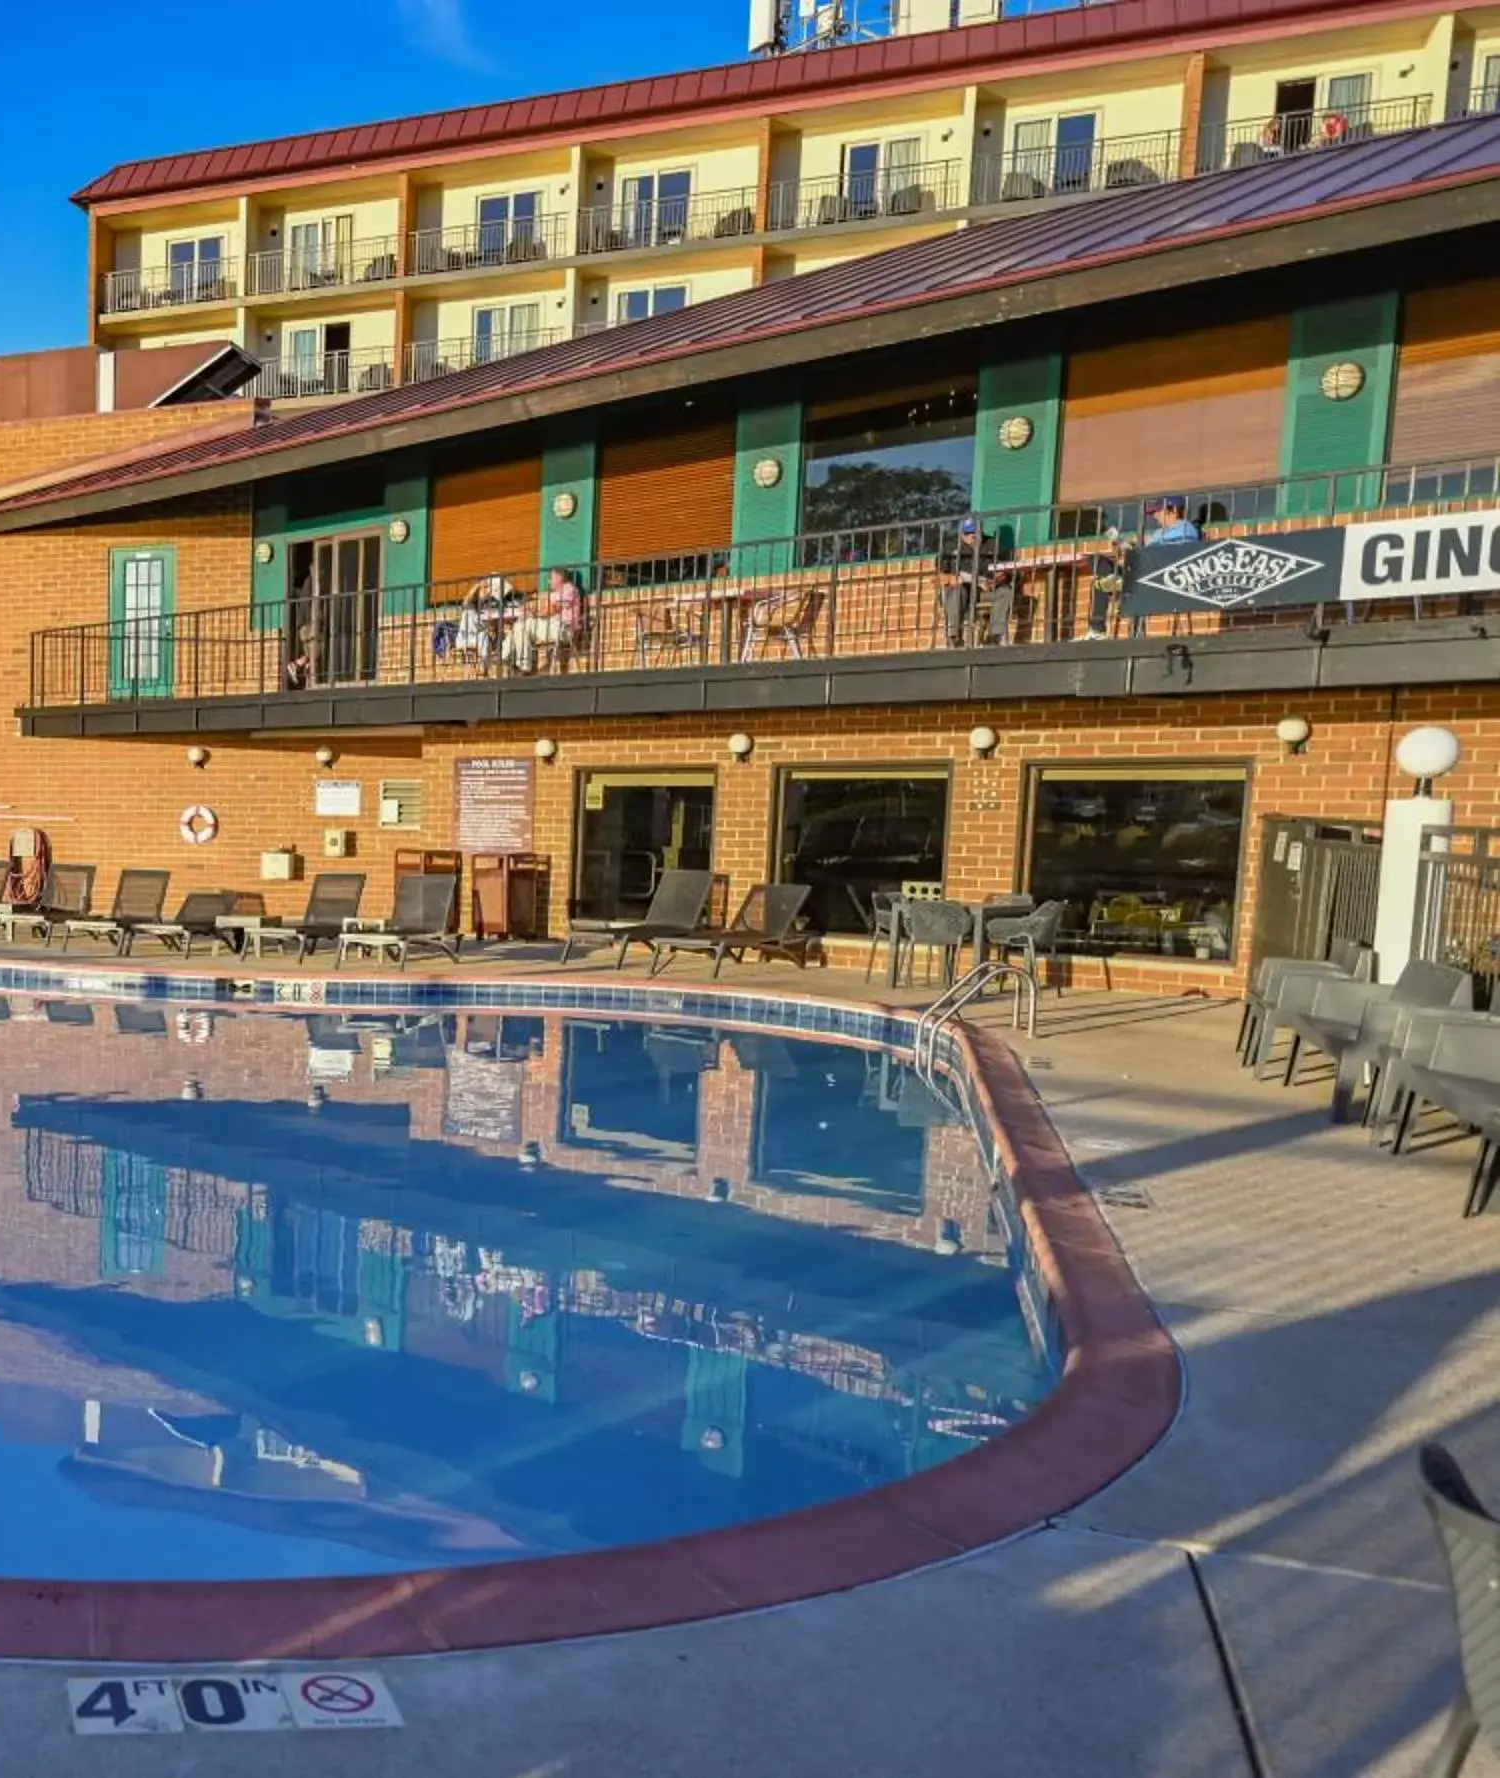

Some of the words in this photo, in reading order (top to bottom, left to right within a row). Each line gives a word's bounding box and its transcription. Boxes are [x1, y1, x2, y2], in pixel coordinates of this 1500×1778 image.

[1163, 549, 1234, 590] GINO'S
[1234, 547, 1297, 582] EAST
[1361, 524, 1500, 586] GIN
[76, 1681, 136, 1727] 4
[133, 1680, 168, 1697] FT
[180, 1679, 246, 1725] 0
[241, 1677, 278, 1694] IN
